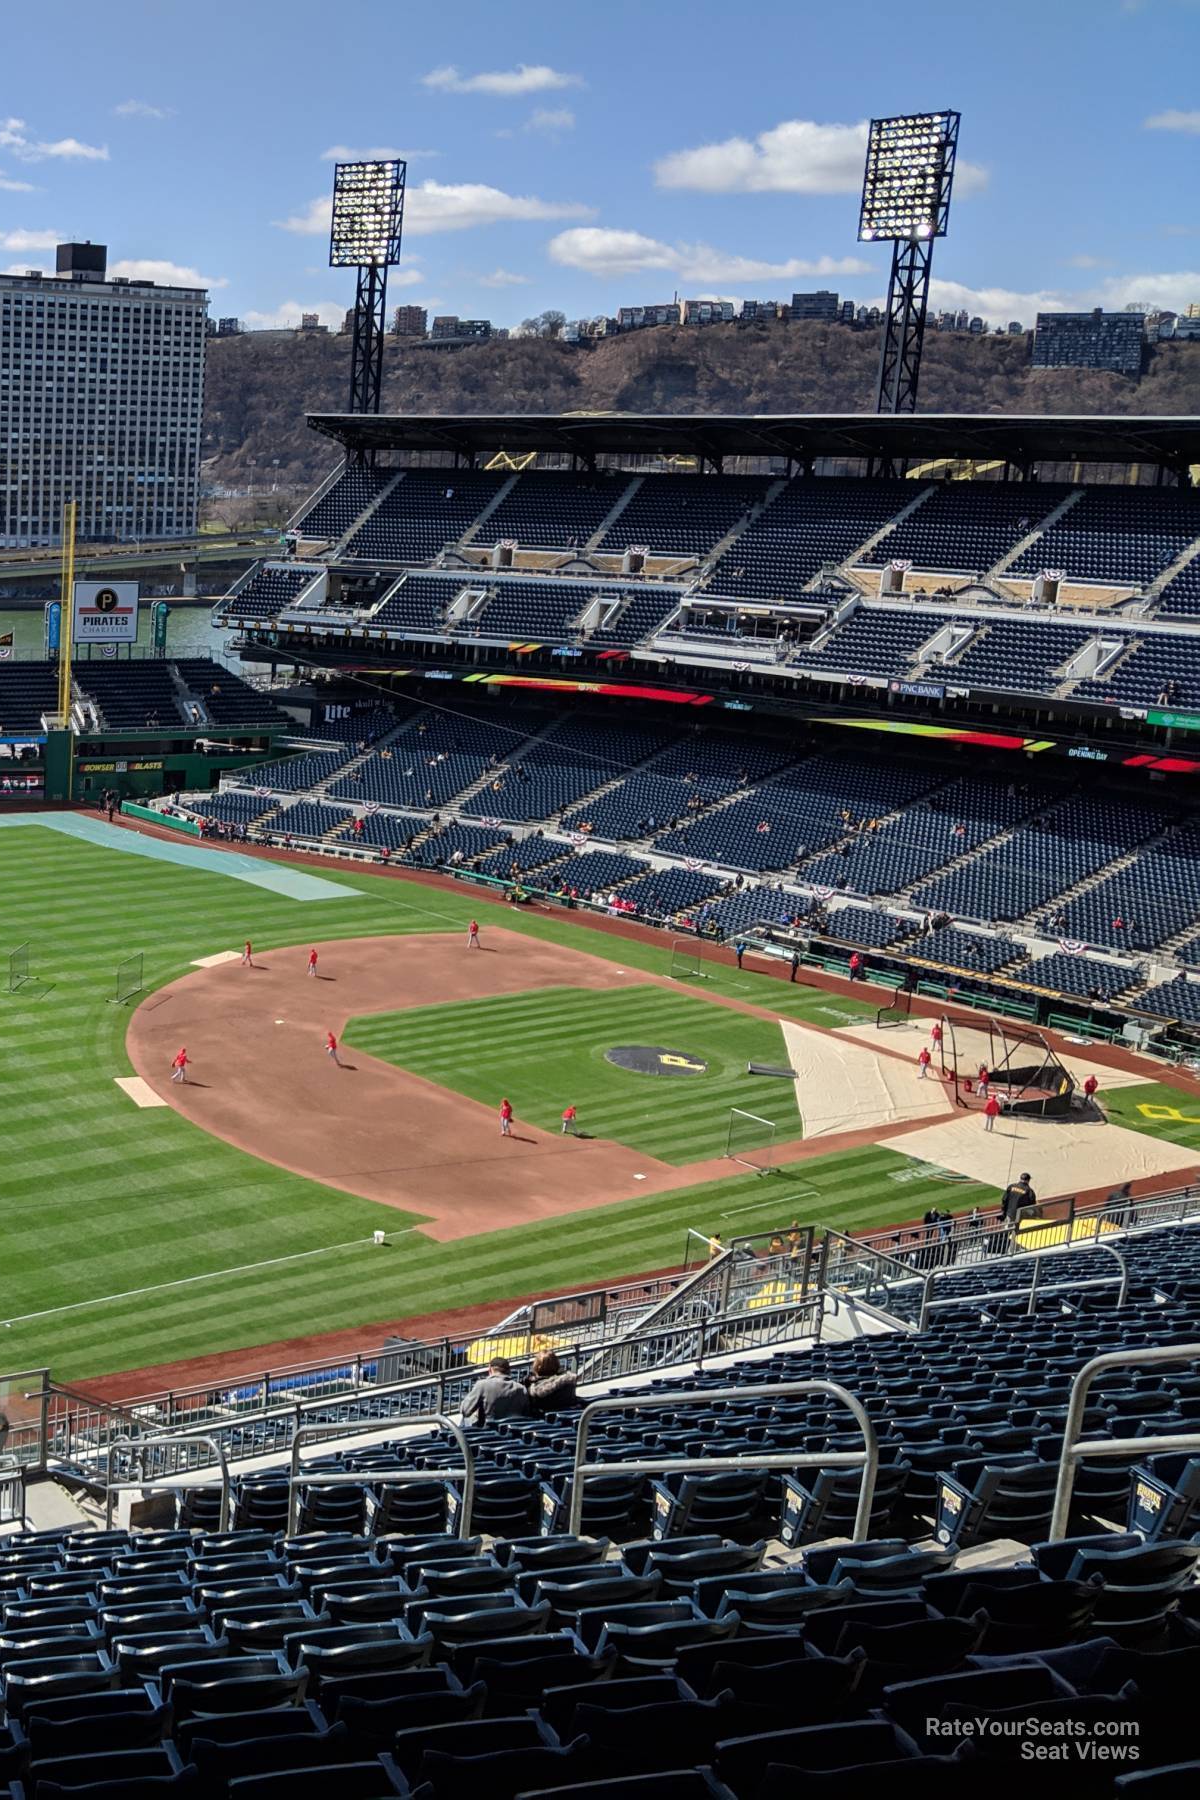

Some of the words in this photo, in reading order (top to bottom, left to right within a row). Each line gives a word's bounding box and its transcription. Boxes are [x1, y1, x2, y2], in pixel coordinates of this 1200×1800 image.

[102, 594, 113, 609] P
[83, 616, 128, 626] PIRATES
[900, 683, 920, 693] PNC
[920, 686, 940, 696] BANK
[325, 704, 350, 722] Lite
[1068, 748, 1096, 759] OPENING
